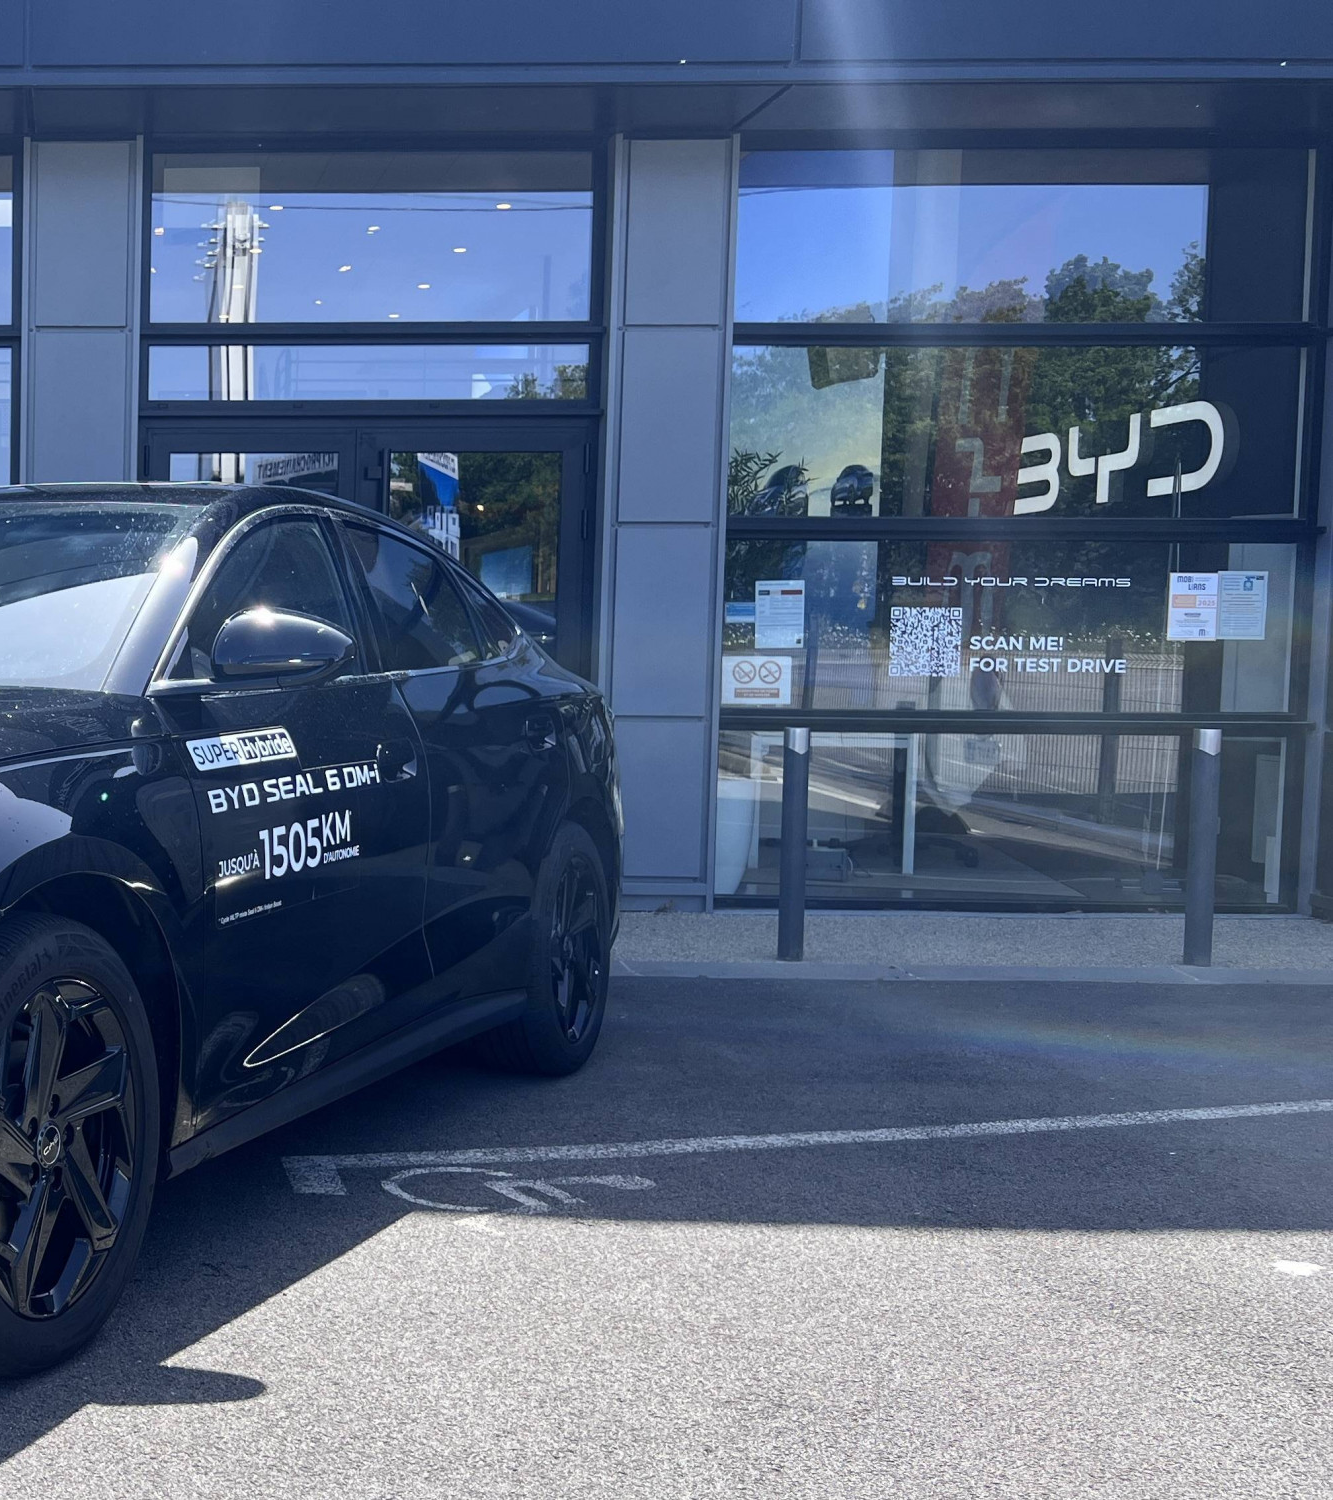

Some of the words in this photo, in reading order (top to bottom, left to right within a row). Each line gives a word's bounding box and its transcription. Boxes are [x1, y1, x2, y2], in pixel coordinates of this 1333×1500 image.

[1014, 400, 1224, 515] BYD
[892, 576, 957, 587] BUILD
[965, 576, 1028, 587] YOUR
[1035, 576, 1131, 588] DREAMS
[970, 636, 1025, 651] SCAN
[1030, 636, 1064, 651] ME!
[970, 658, 1010, 674] FOR
[1015, 658, 1062, 674] TEST
[1067, 658, 1127, 674] DRIVE
[192, 741, 242, 766] SUPER
[244, 733, 293, 762] Hybride
[207, 782, 260, 814] BYD
[263, 771, 323, 803] SEAL
[325, 768, 341, 791] 6
[342, 763, 381, 789] DM-i
[218, 848, 261, 878] JUSQU'À
